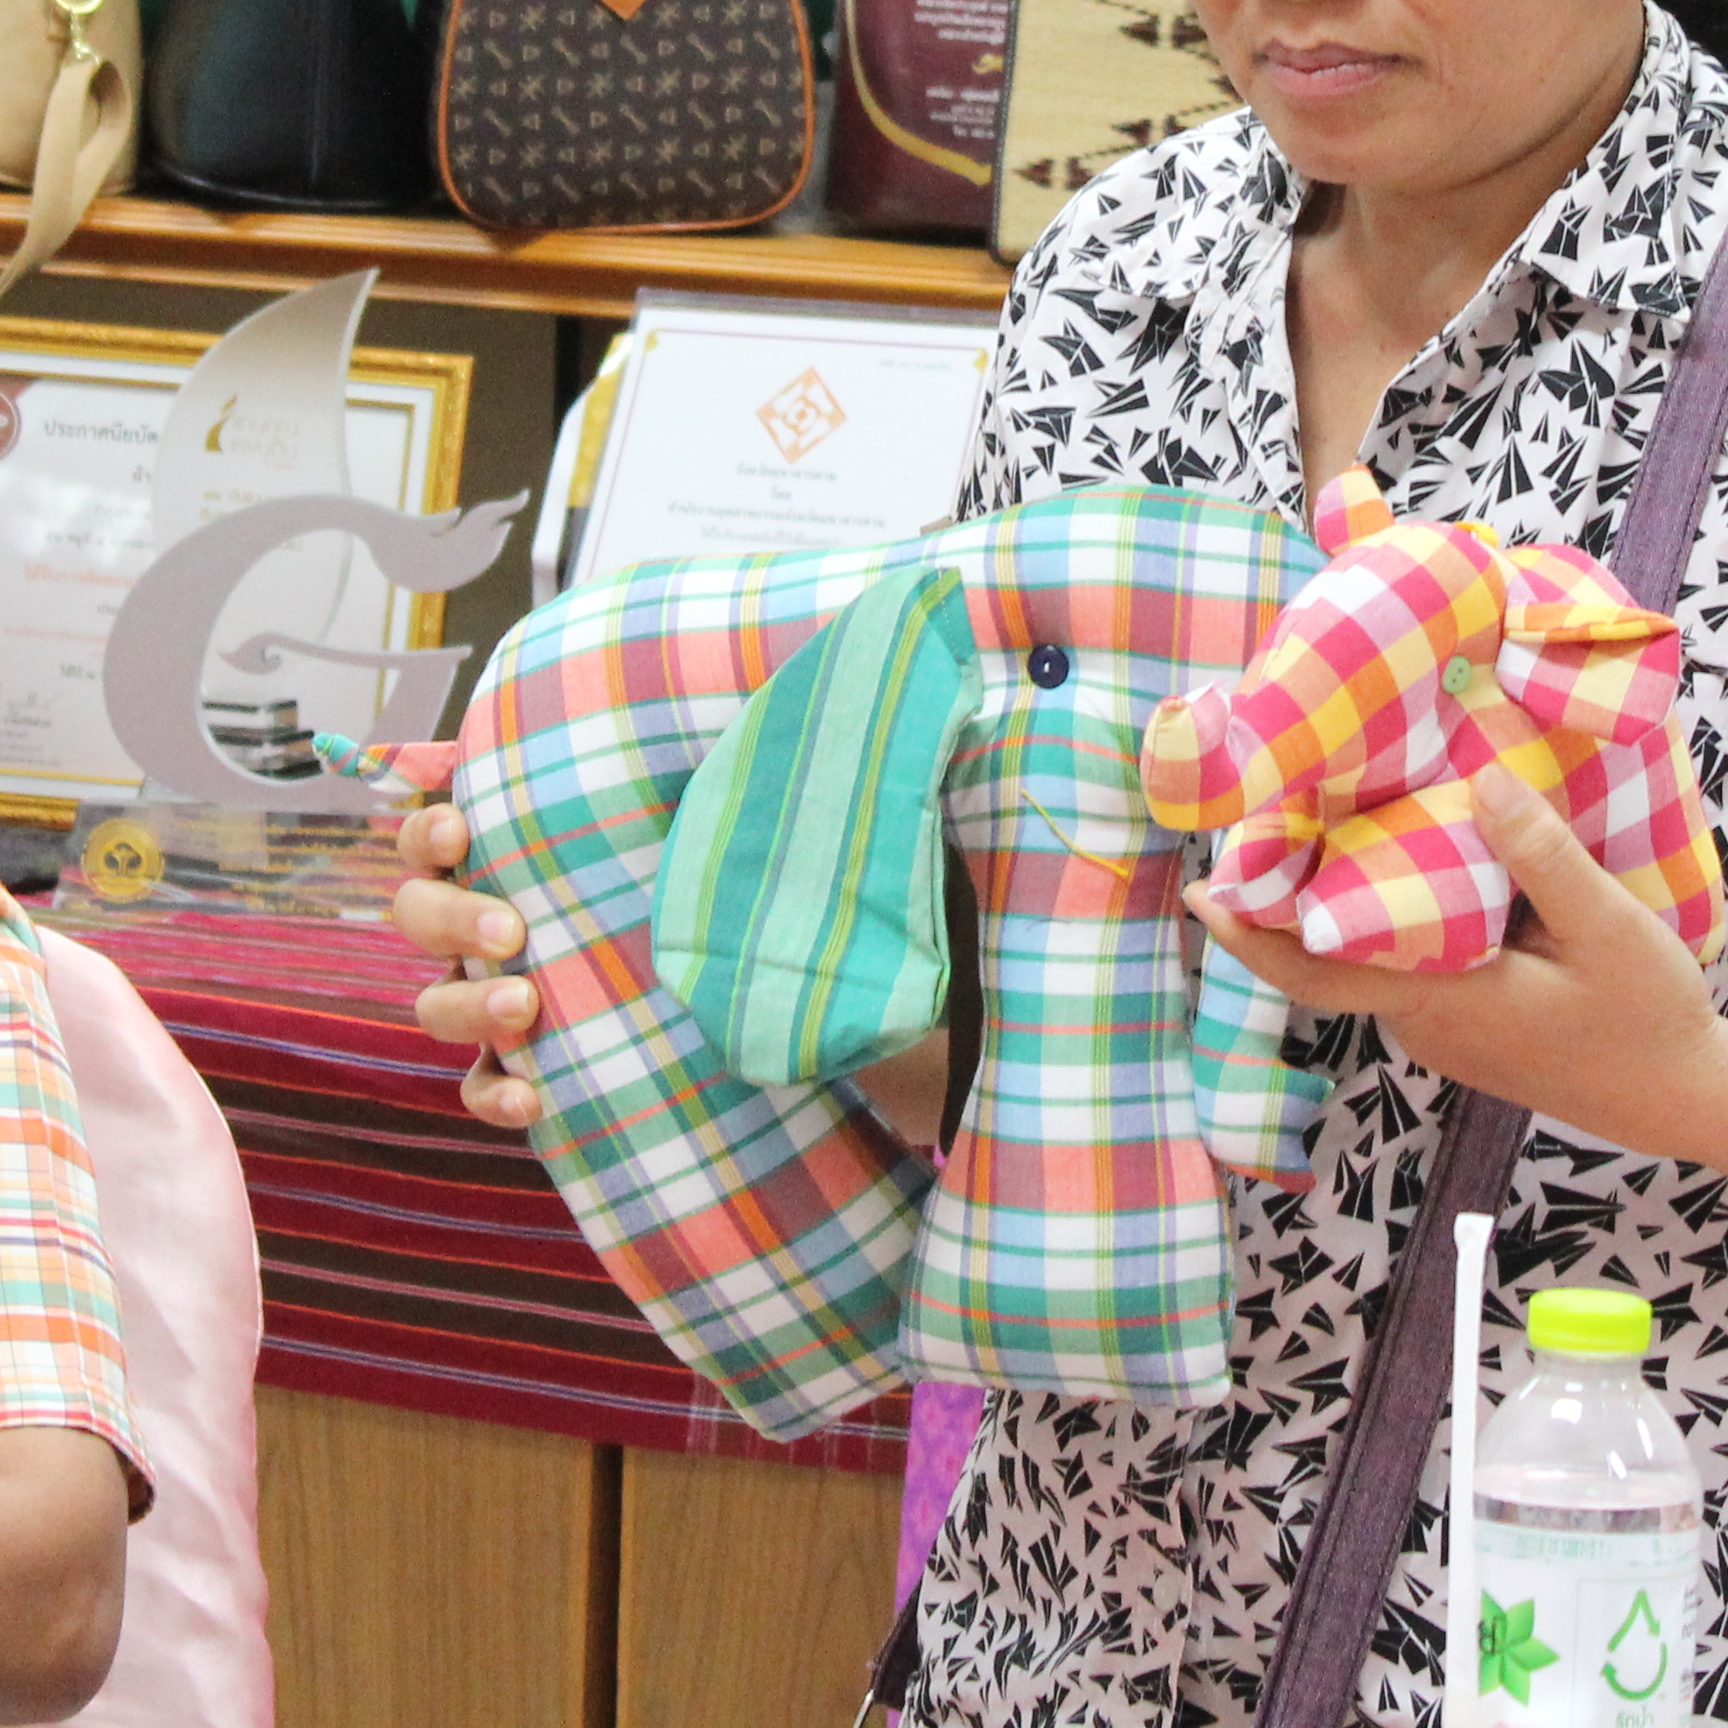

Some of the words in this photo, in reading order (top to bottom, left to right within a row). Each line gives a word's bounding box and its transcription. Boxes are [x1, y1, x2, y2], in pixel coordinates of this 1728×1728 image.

[43, 417, 159, 446] ประกาศนียบัต
